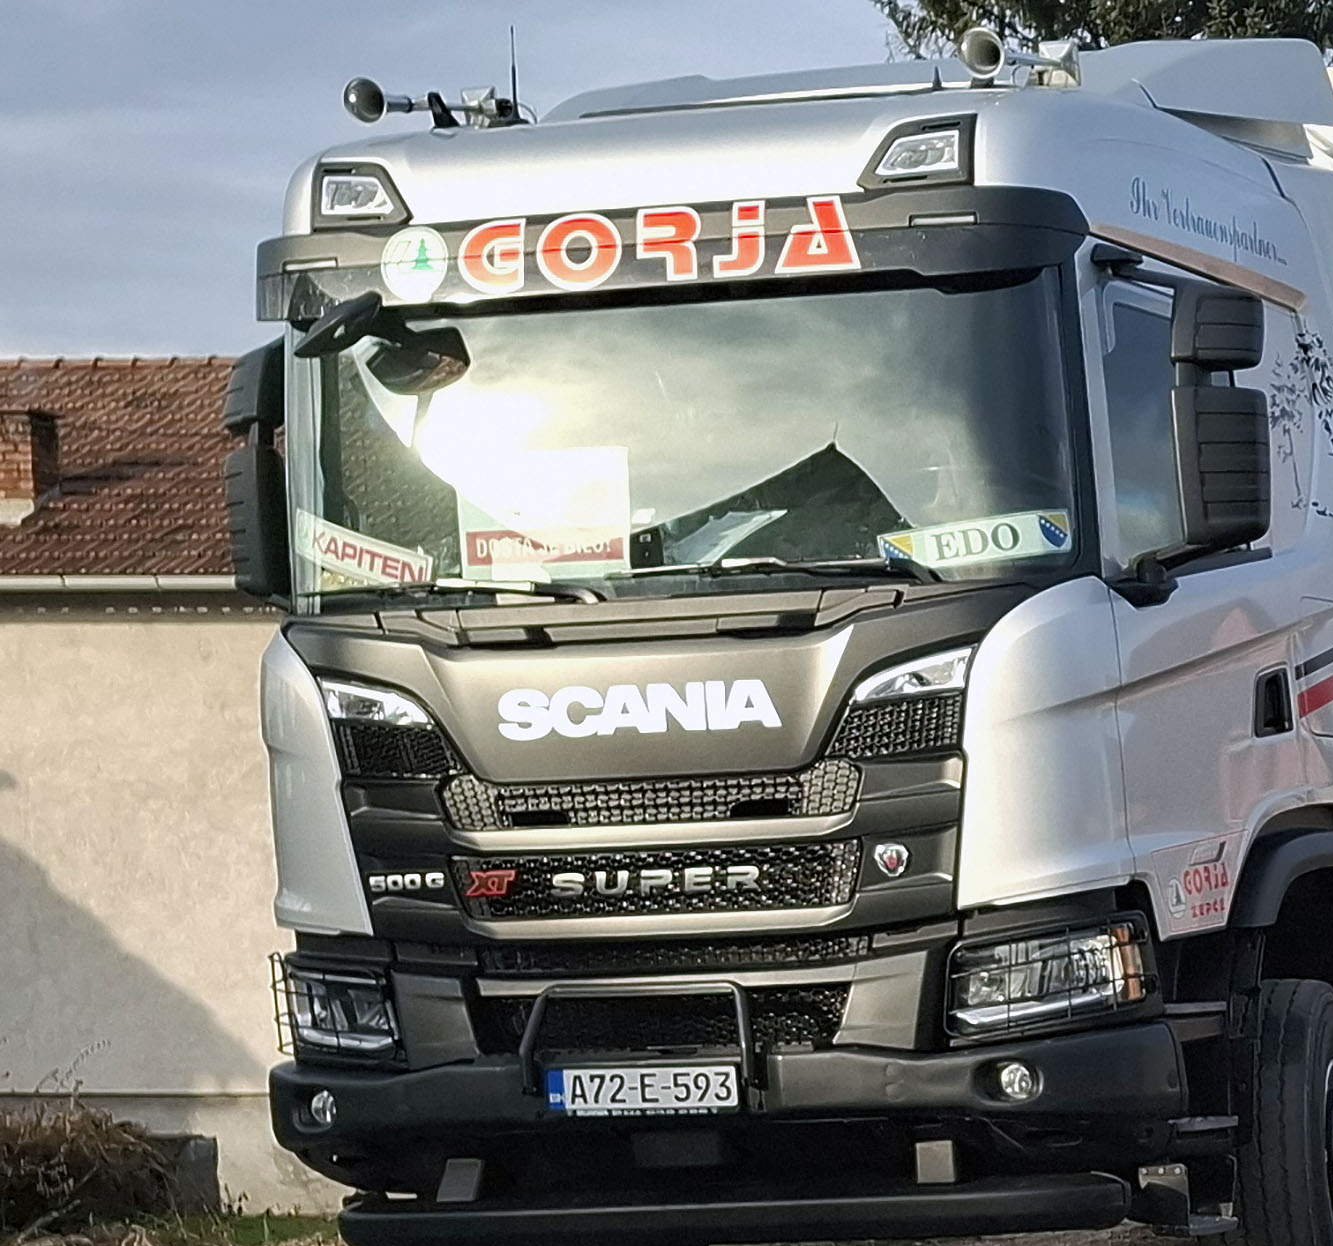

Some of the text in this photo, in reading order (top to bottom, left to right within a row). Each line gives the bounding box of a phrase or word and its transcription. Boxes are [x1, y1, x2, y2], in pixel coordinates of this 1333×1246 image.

[1130, 177, 1158, 221] Ihr
[457, 196, 862, 294] GORJA
[312, 531, 424, 583] KAPITEN
[931, 522, 1021, 562] EDO
[497, 678, 783, 741] SCANIA
[369, 871, 445, 893] 500 G
[463, 865, 761, 897] XT SUPER
[570, 1071, 732, 1105] A72-E-593
